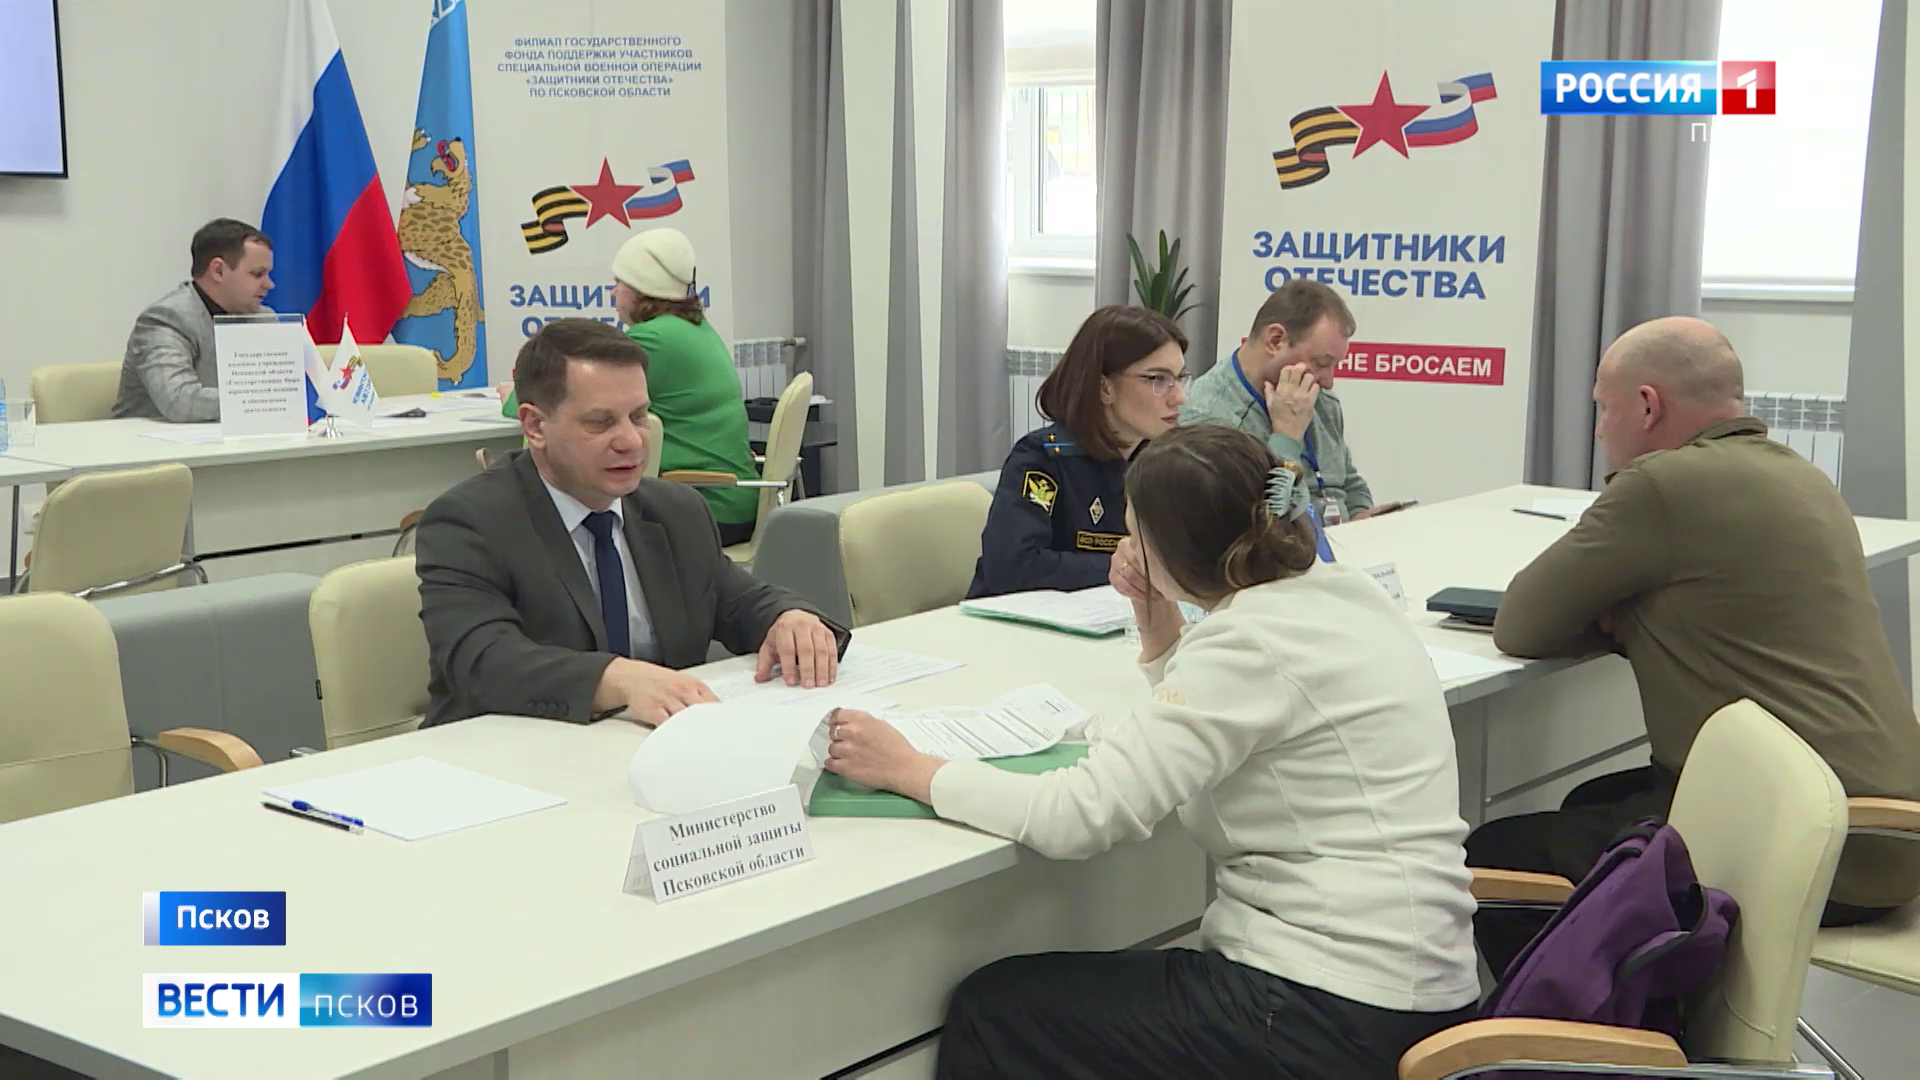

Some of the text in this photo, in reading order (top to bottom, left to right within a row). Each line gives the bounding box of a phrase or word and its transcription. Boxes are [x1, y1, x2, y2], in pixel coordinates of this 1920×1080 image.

[515, 36, 681, 48] ФИЛИАЛ ГОСУДАРСТВЕННОГО
[504, 49, 693, 60] ФОНДА ПОДДЕРЖКИ УЧАСТНИКОВ
[497, 61, 702, 73] СПЕЦИАЛЬНОЙ ВОЕННОЙ ОПЕРАЦИИ
[526, 74, 673, 85] «ЗАЩИТНИКИ ОТЕЧЕСТВА»
[530, 86, 671, 97] ПО ПСКОВСКОЙ ОБЛАСТИ
[1252, 231, 1505, 264] ЗАЩИТНИКИ
[510, 285, 711, 309] ЗАЩИТИ
[1337, 353, 1492, 377] НЕ БРОСАЕМ
[669, 802, 776, 841] Министерство
[653, 821, 802, 872] социальной защиты
[663, 846, 805, 896] Псковской области
